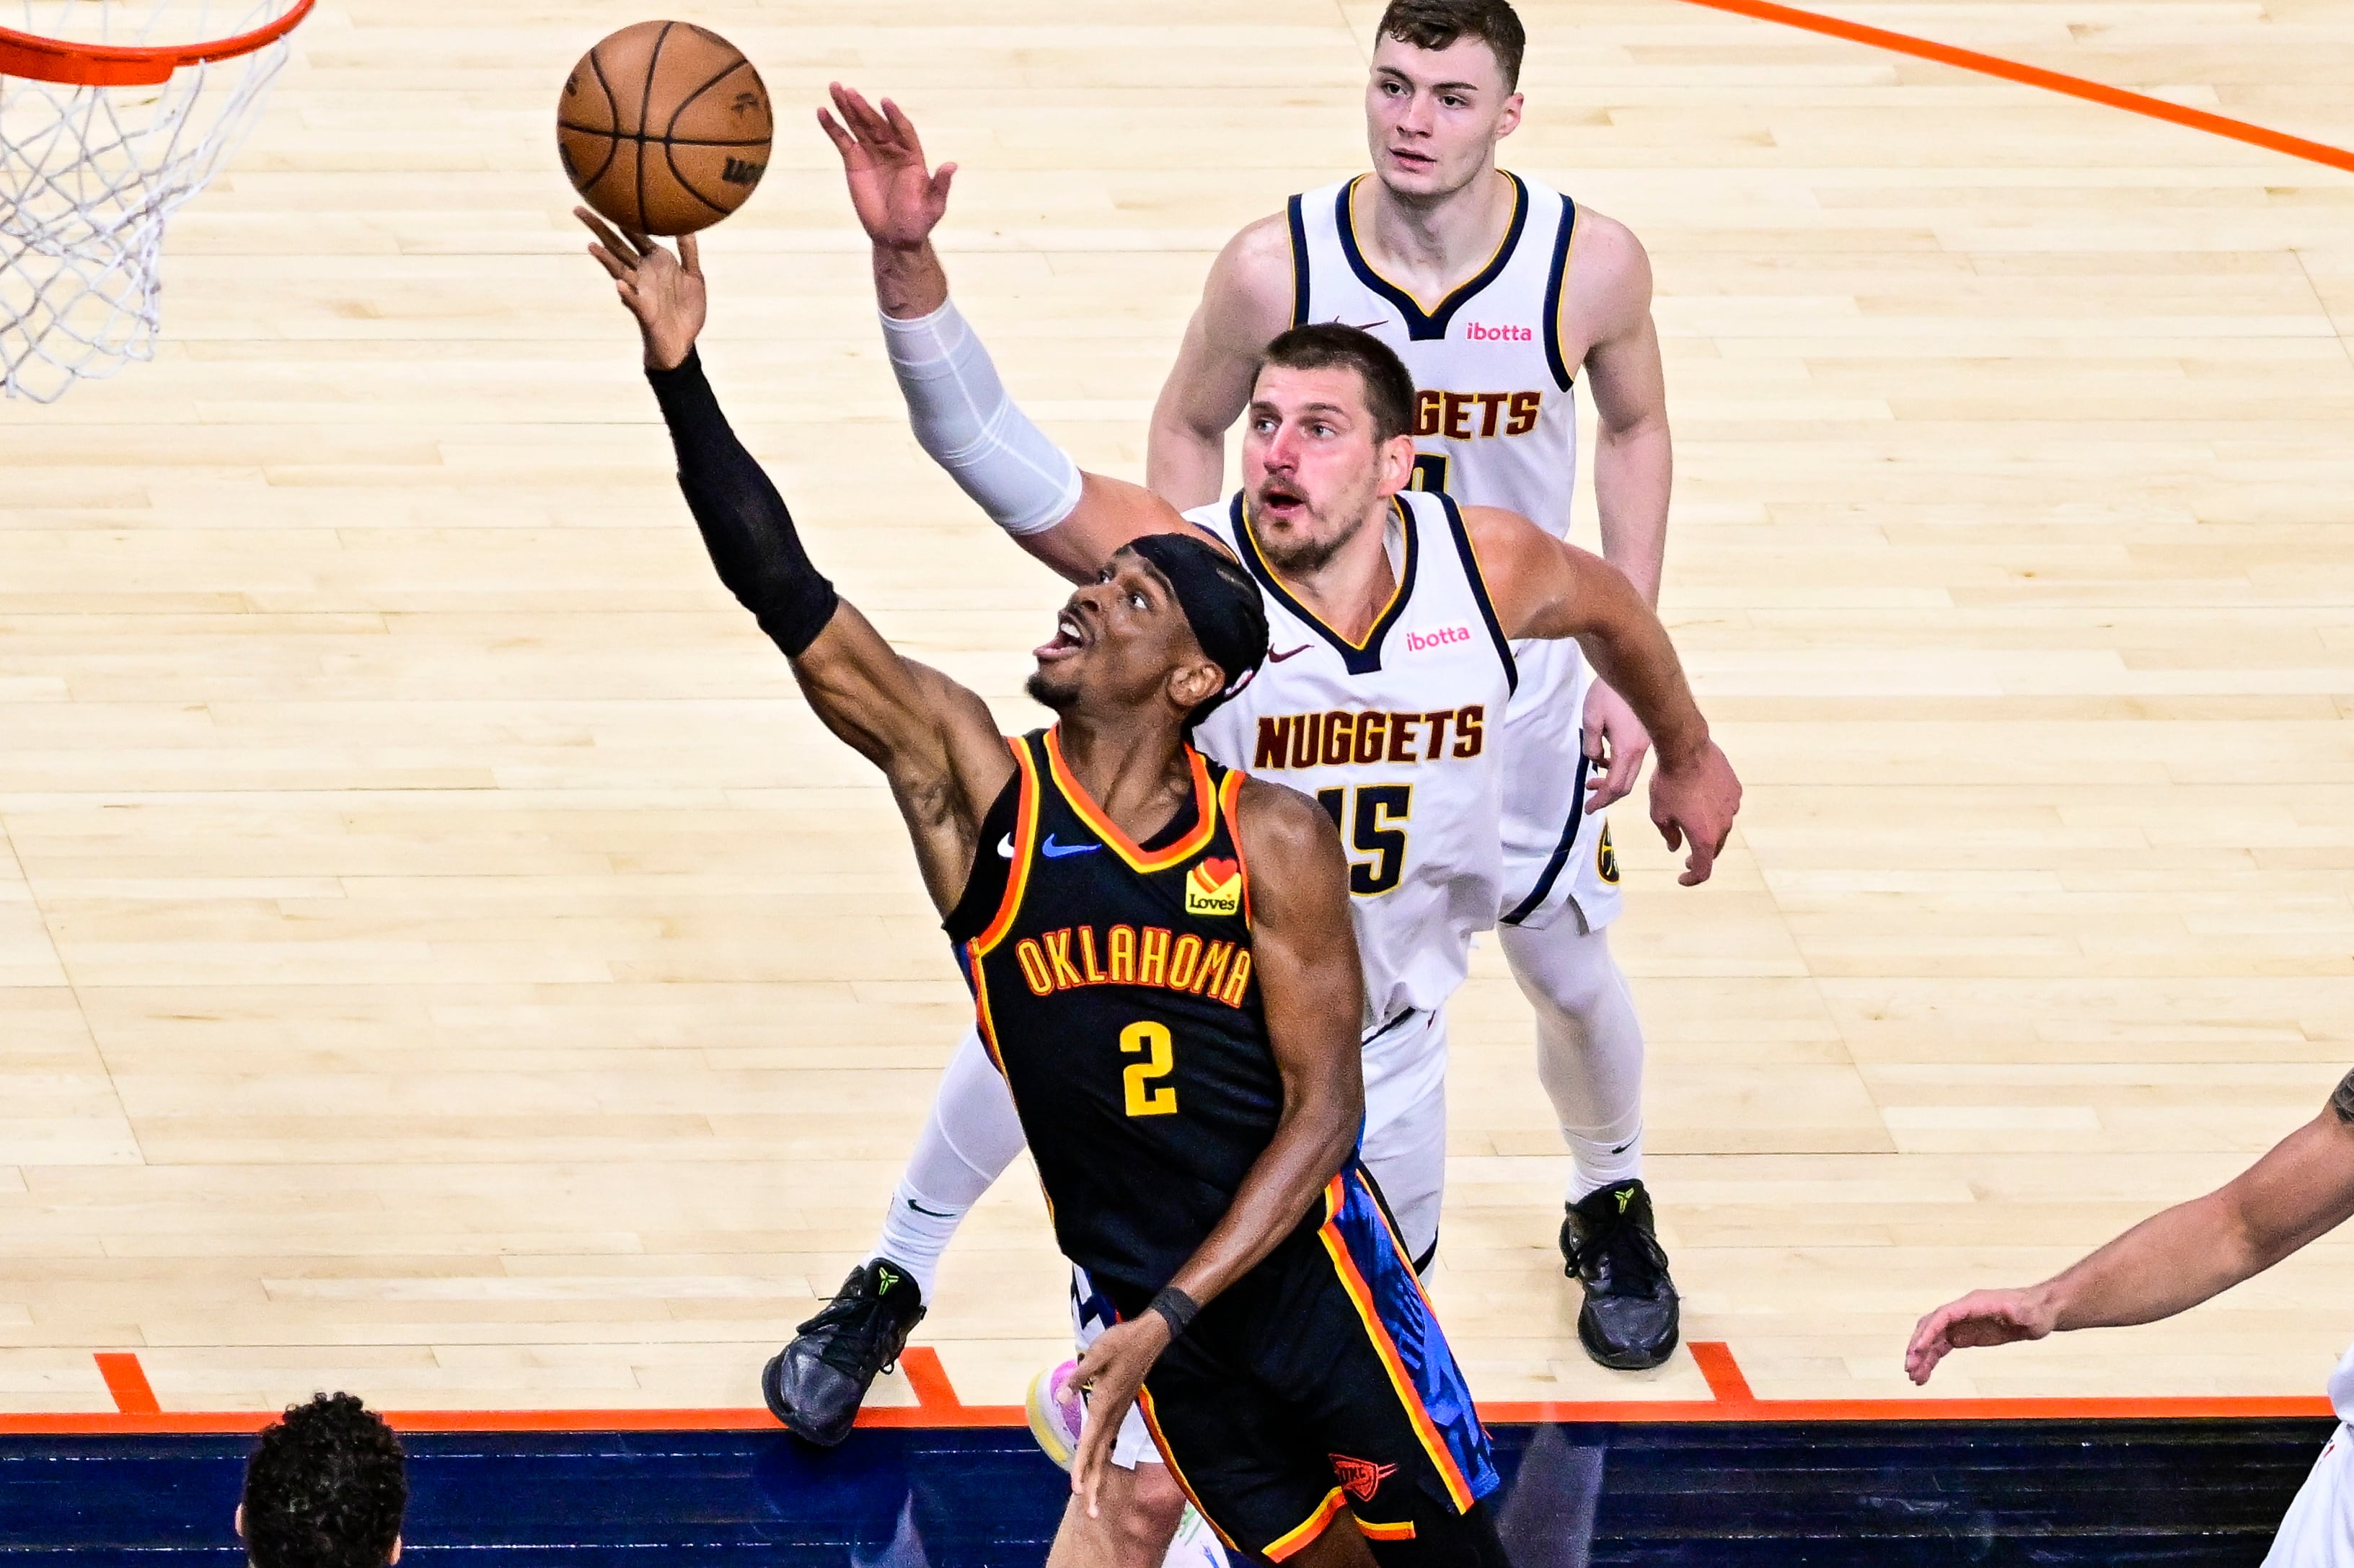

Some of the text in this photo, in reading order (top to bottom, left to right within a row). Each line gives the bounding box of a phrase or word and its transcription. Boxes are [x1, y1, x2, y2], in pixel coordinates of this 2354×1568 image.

[1467, 322, 1532, 341] ibotta
[1414, 389, 1543, 441] GETS
[1407, 626, 1471, 652] ibotta
[1253, 704, 1485, 770] NUGGETS
[1015, 924, 1251, 1009] OKLAHOMA
[1119, 1021, 1178, 1117] 2
